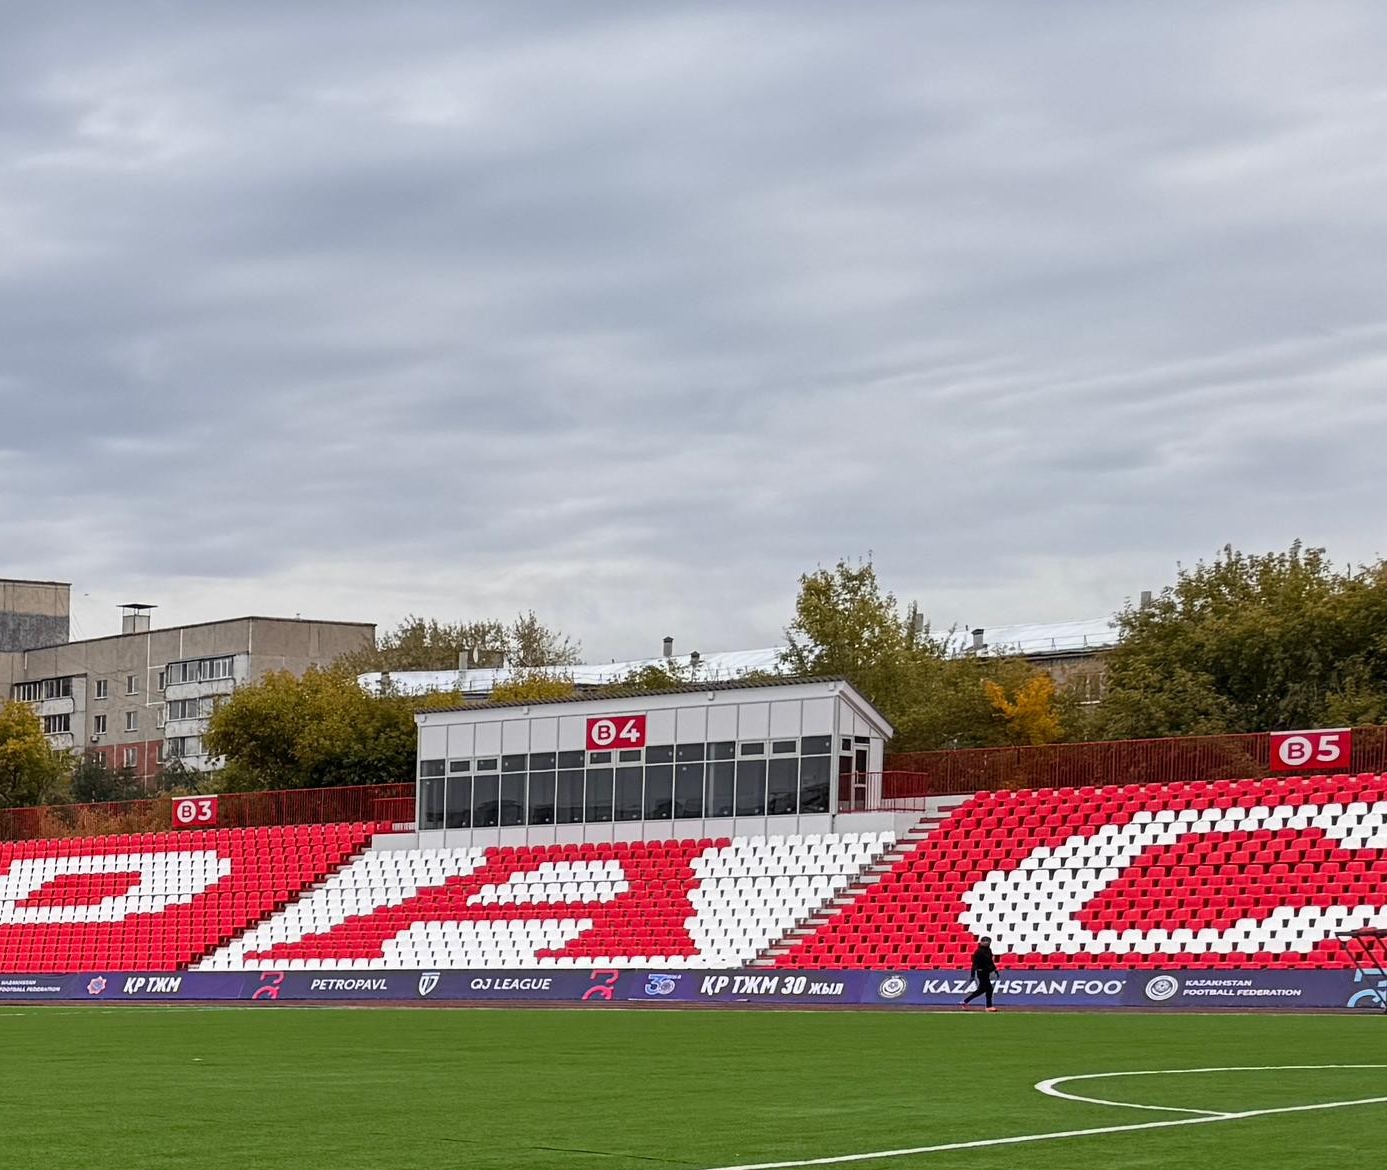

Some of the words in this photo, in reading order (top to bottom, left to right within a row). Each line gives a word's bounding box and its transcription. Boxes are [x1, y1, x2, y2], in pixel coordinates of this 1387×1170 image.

[123, 977, 145, 995] ҚР
[146, 977, 182, 992] ТЖМ
[310, 979, 388, 991] PETROPAVL
[470, 978, 493, 991] QJ
[494, 978, 552, 991] LEAGUE
[700, 976, 730, 996] ҚР
[731, 976, 778, 994] ТЖМ
[781, 976, 807, 995] 30
[808, 982, 844, 995] жыл
[923, 979, 1067, 994] KAZAHSTAN
[1070, 979, 1126, 995] FOO
